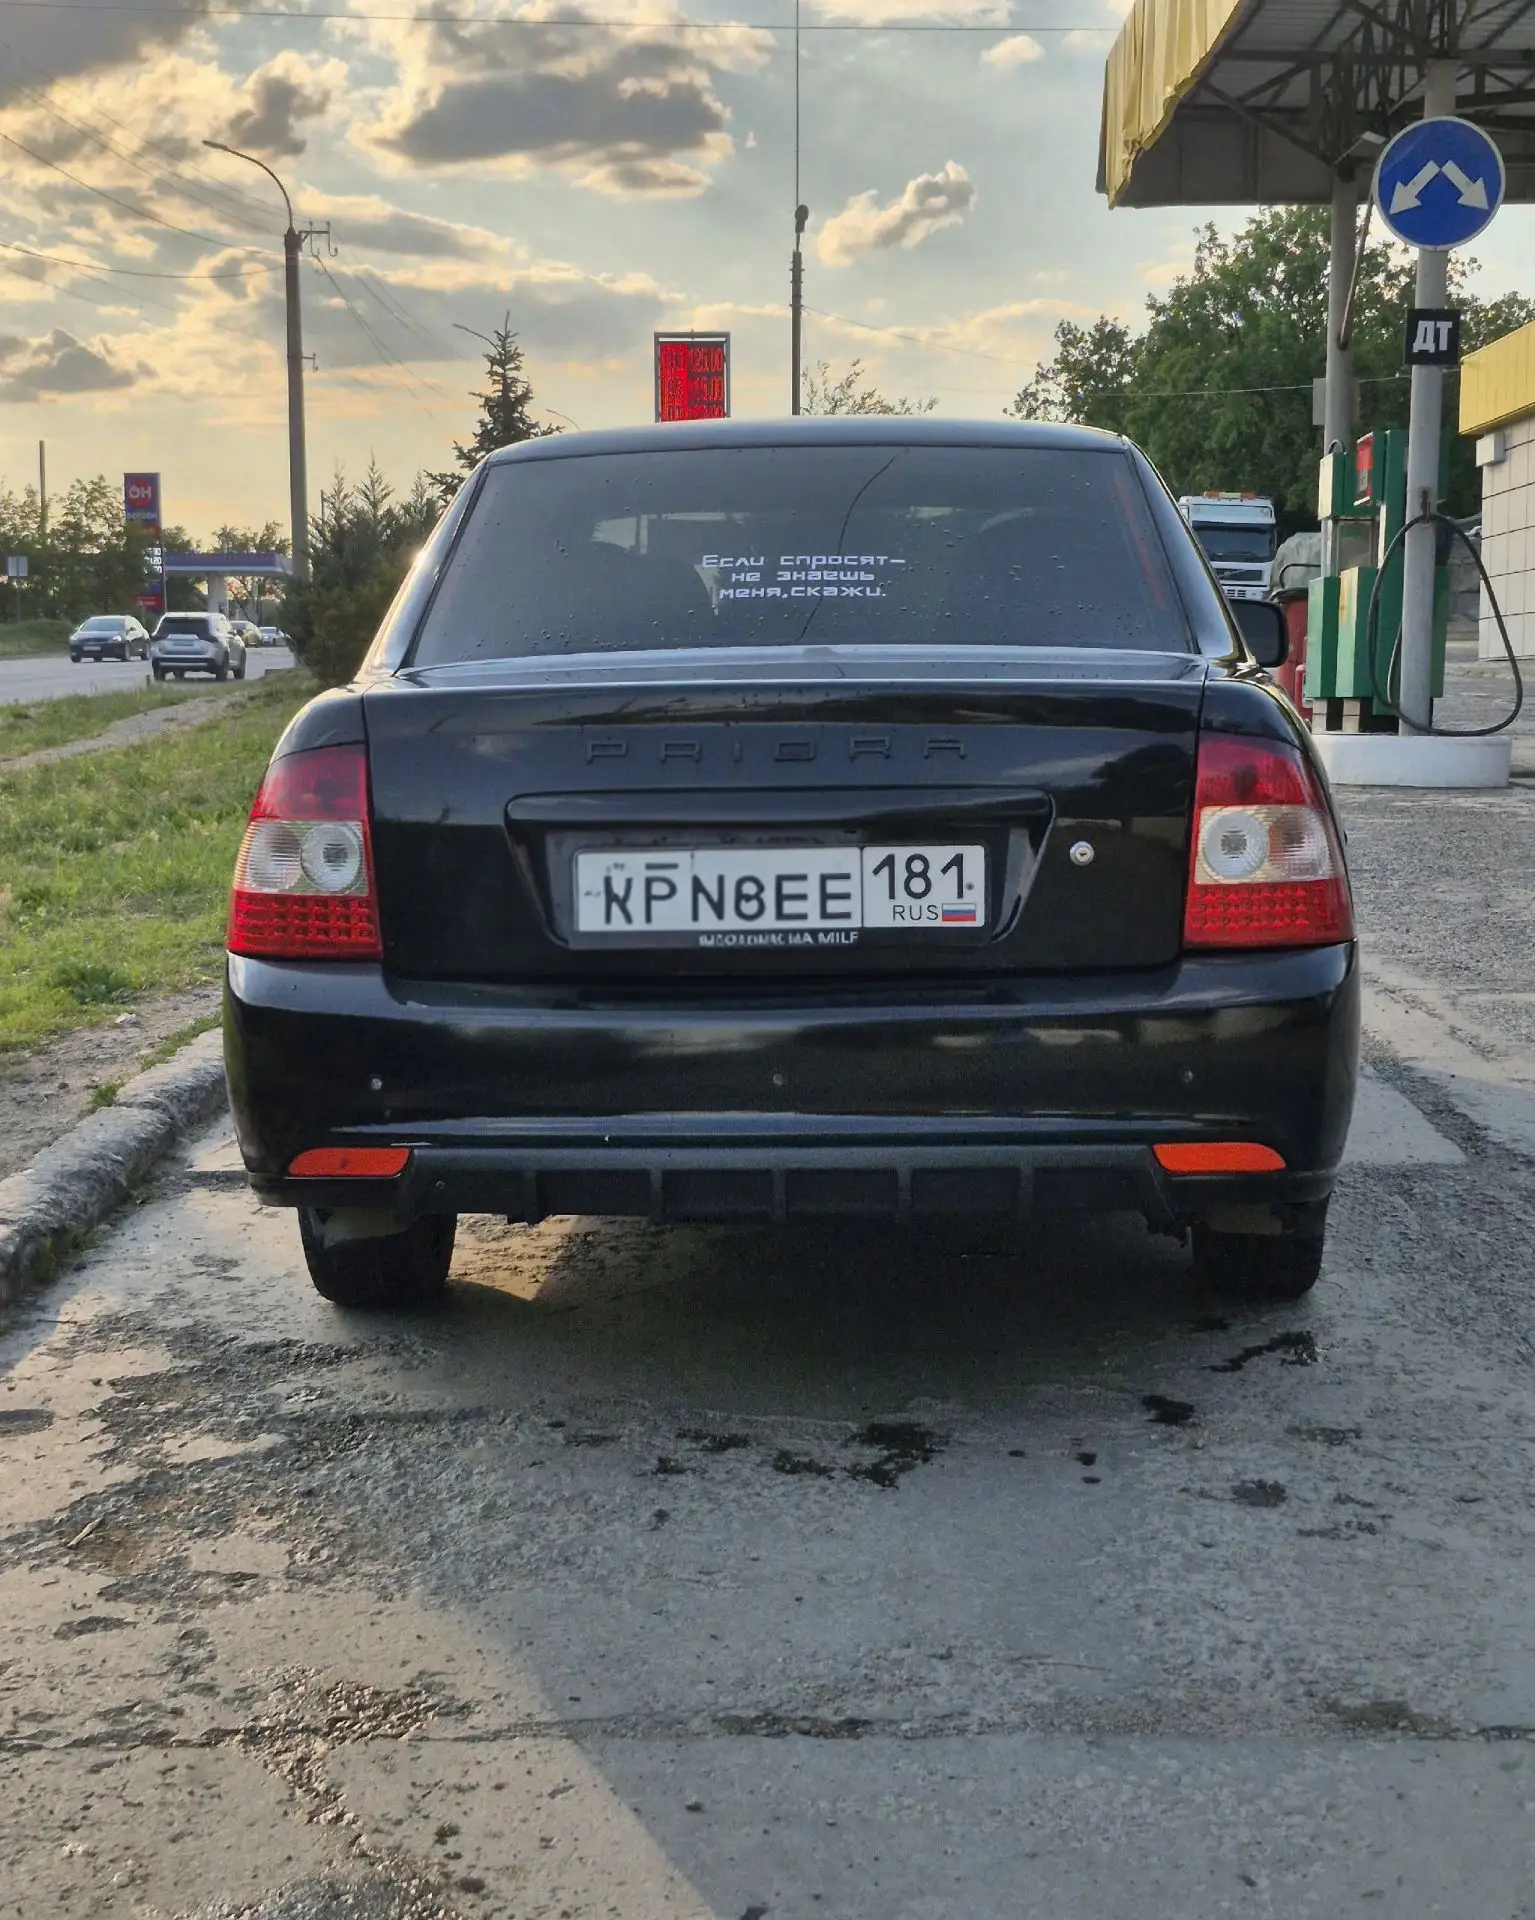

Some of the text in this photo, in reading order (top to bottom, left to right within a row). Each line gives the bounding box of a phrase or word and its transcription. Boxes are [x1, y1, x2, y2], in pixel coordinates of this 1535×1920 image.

[1412, 320, 1453, 353] ДТ
[702, 554, 764, 568] Если
[731, 571, 875, 582] не знаешь
[586, 735, 967, 763] PRIORA
[872, 853, 964, 900] 181
[892, 904, 939, 921] RUS
[818, 931, 859, 944] MILF
